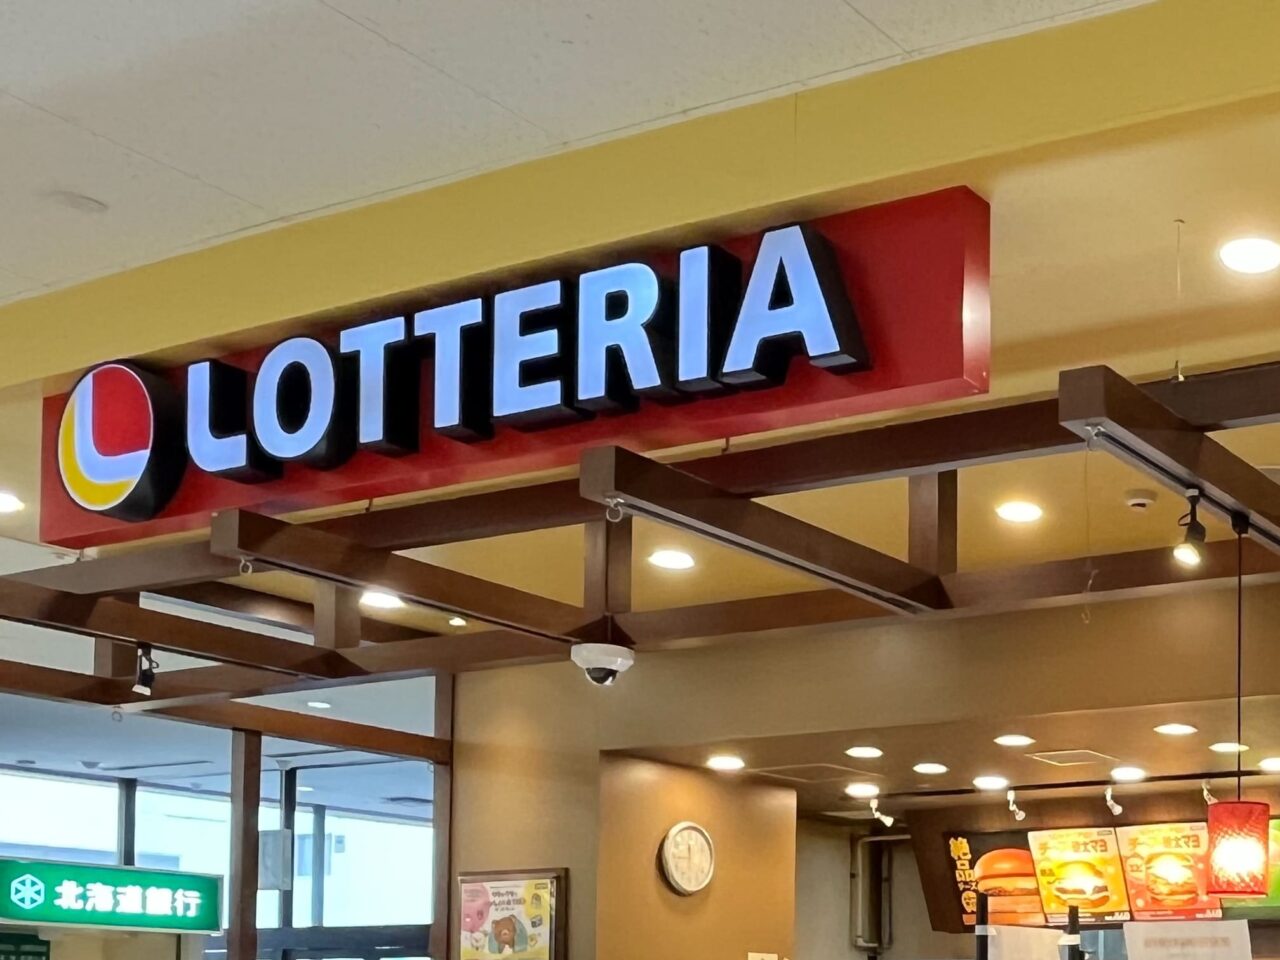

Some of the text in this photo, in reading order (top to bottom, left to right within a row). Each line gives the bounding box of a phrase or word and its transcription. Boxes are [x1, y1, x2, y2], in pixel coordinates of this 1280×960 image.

[187, 225, 841, 472] LOTTERIA
[53, 879, 202, 918] 北海道銀行
